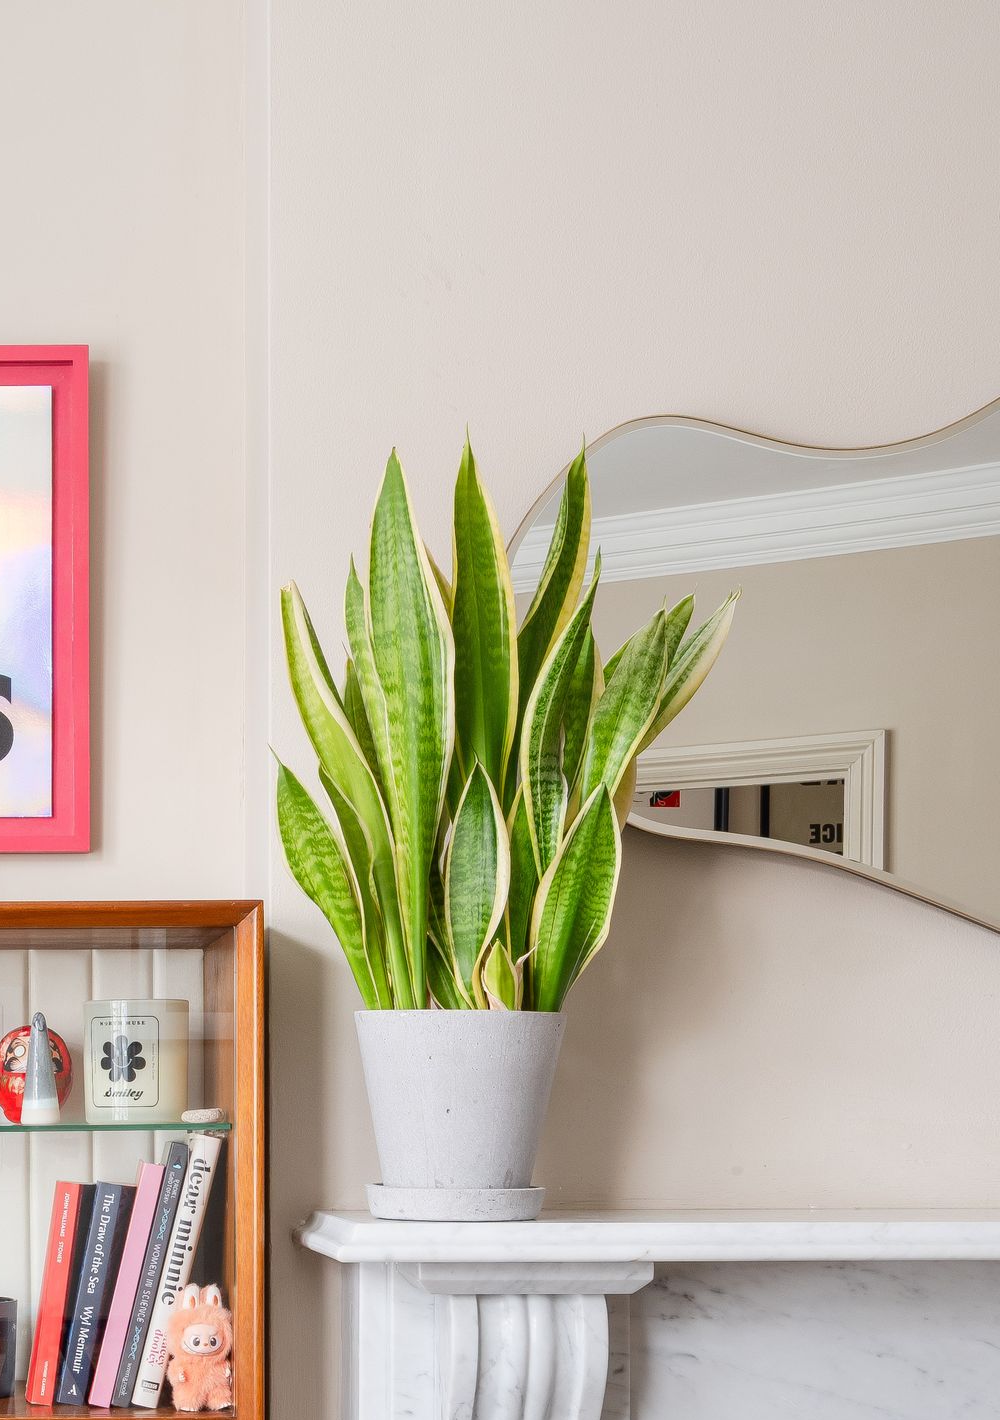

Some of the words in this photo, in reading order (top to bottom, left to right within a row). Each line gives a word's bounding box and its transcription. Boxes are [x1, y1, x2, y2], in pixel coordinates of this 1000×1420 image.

[103, 1087, 144, 1101] Smiley
[182, 1157, 211, 1215] dear
[102, 1193, 115, 1213] The
[98, 1214, 111, 1243] Draw
[94, 1243, 106, 1258] of
[147, 1243, 161, 1277] WOMEN
[161, 1219, 193, 1306] minnie
[91, 1258, 104, 1274] the
[86, 1274, 100, 1294] Sea
[143, 1278, 153, 1288] IN
[81, 1306, 94, 1325] Wyl
[136, 1288, 150, 1323] SCIENCE
[72, 1326, 90, 1375] Menmuir
[146, 1329, 164, 1368] dooley
